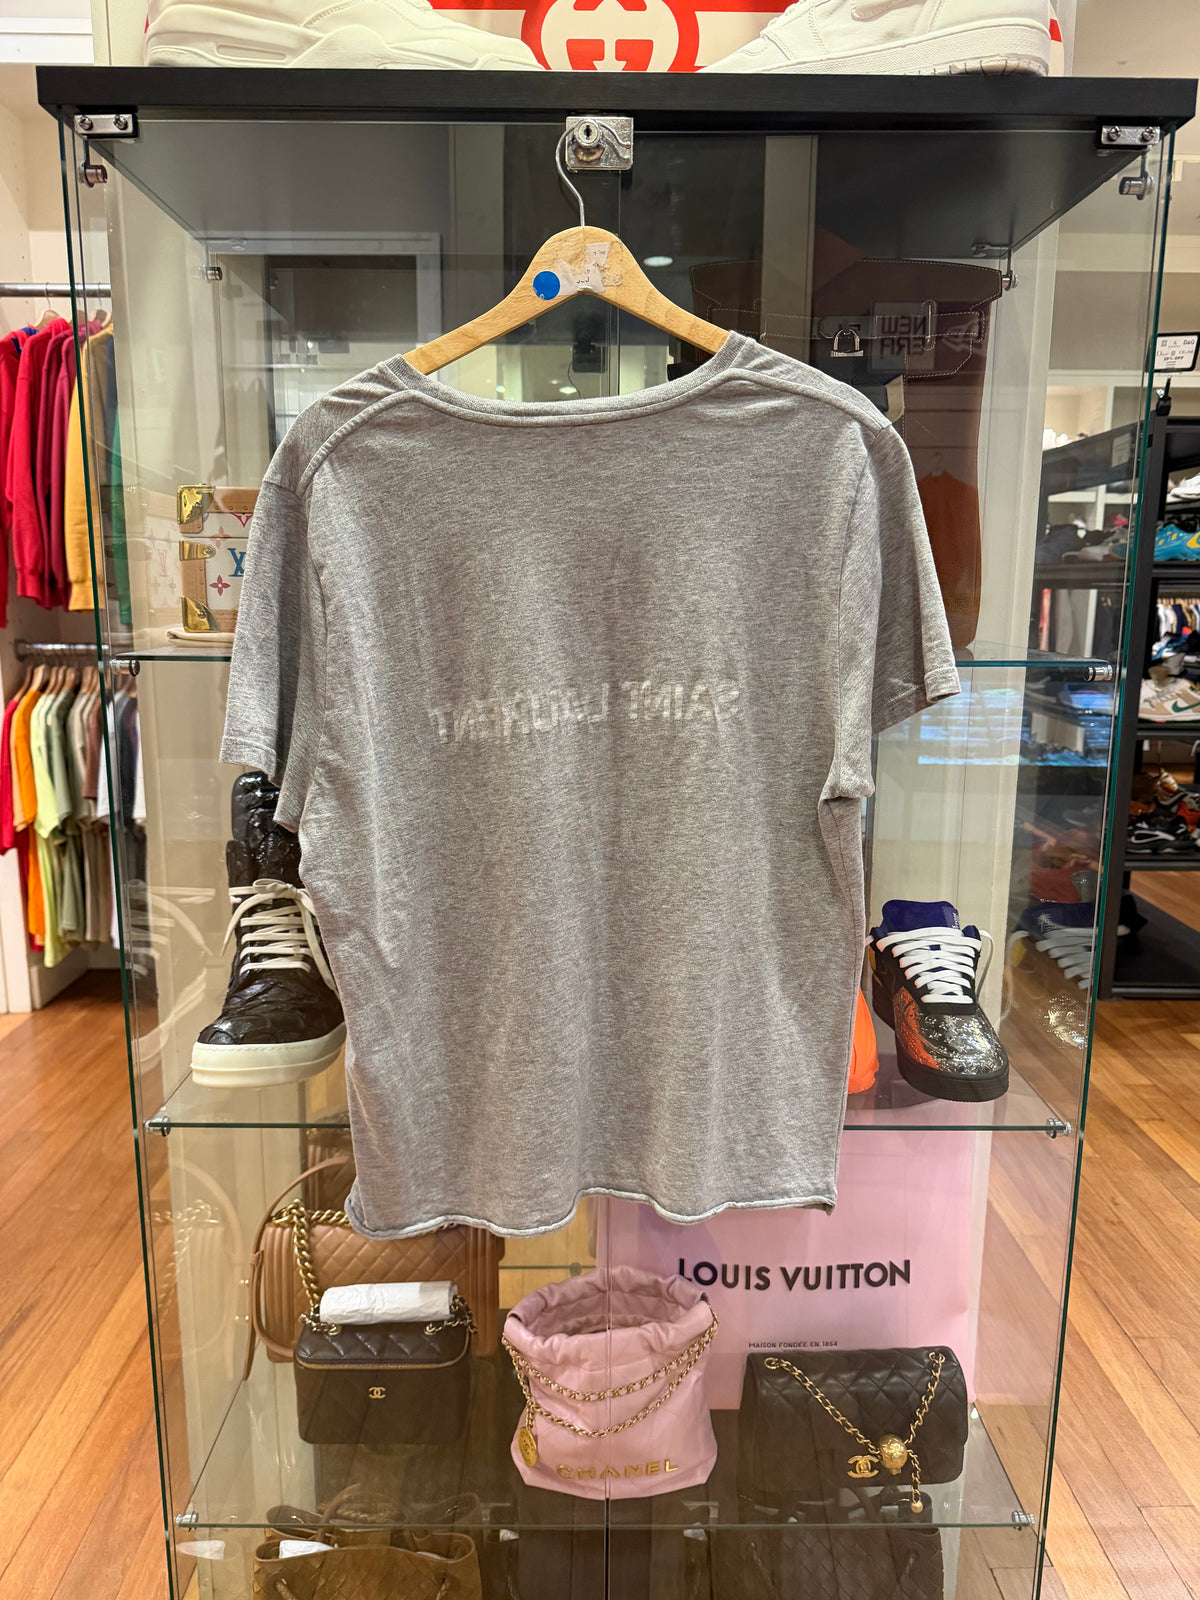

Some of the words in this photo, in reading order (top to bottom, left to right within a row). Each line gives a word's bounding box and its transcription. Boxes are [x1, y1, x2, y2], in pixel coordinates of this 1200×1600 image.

[678, 1257, 771, 1291] LOUIS
[780, 1259, 911, 1292] VUITTON
[748, 1341, 777, 1349] MAISON
[556, 1458, 679, 1480] CHANEL
